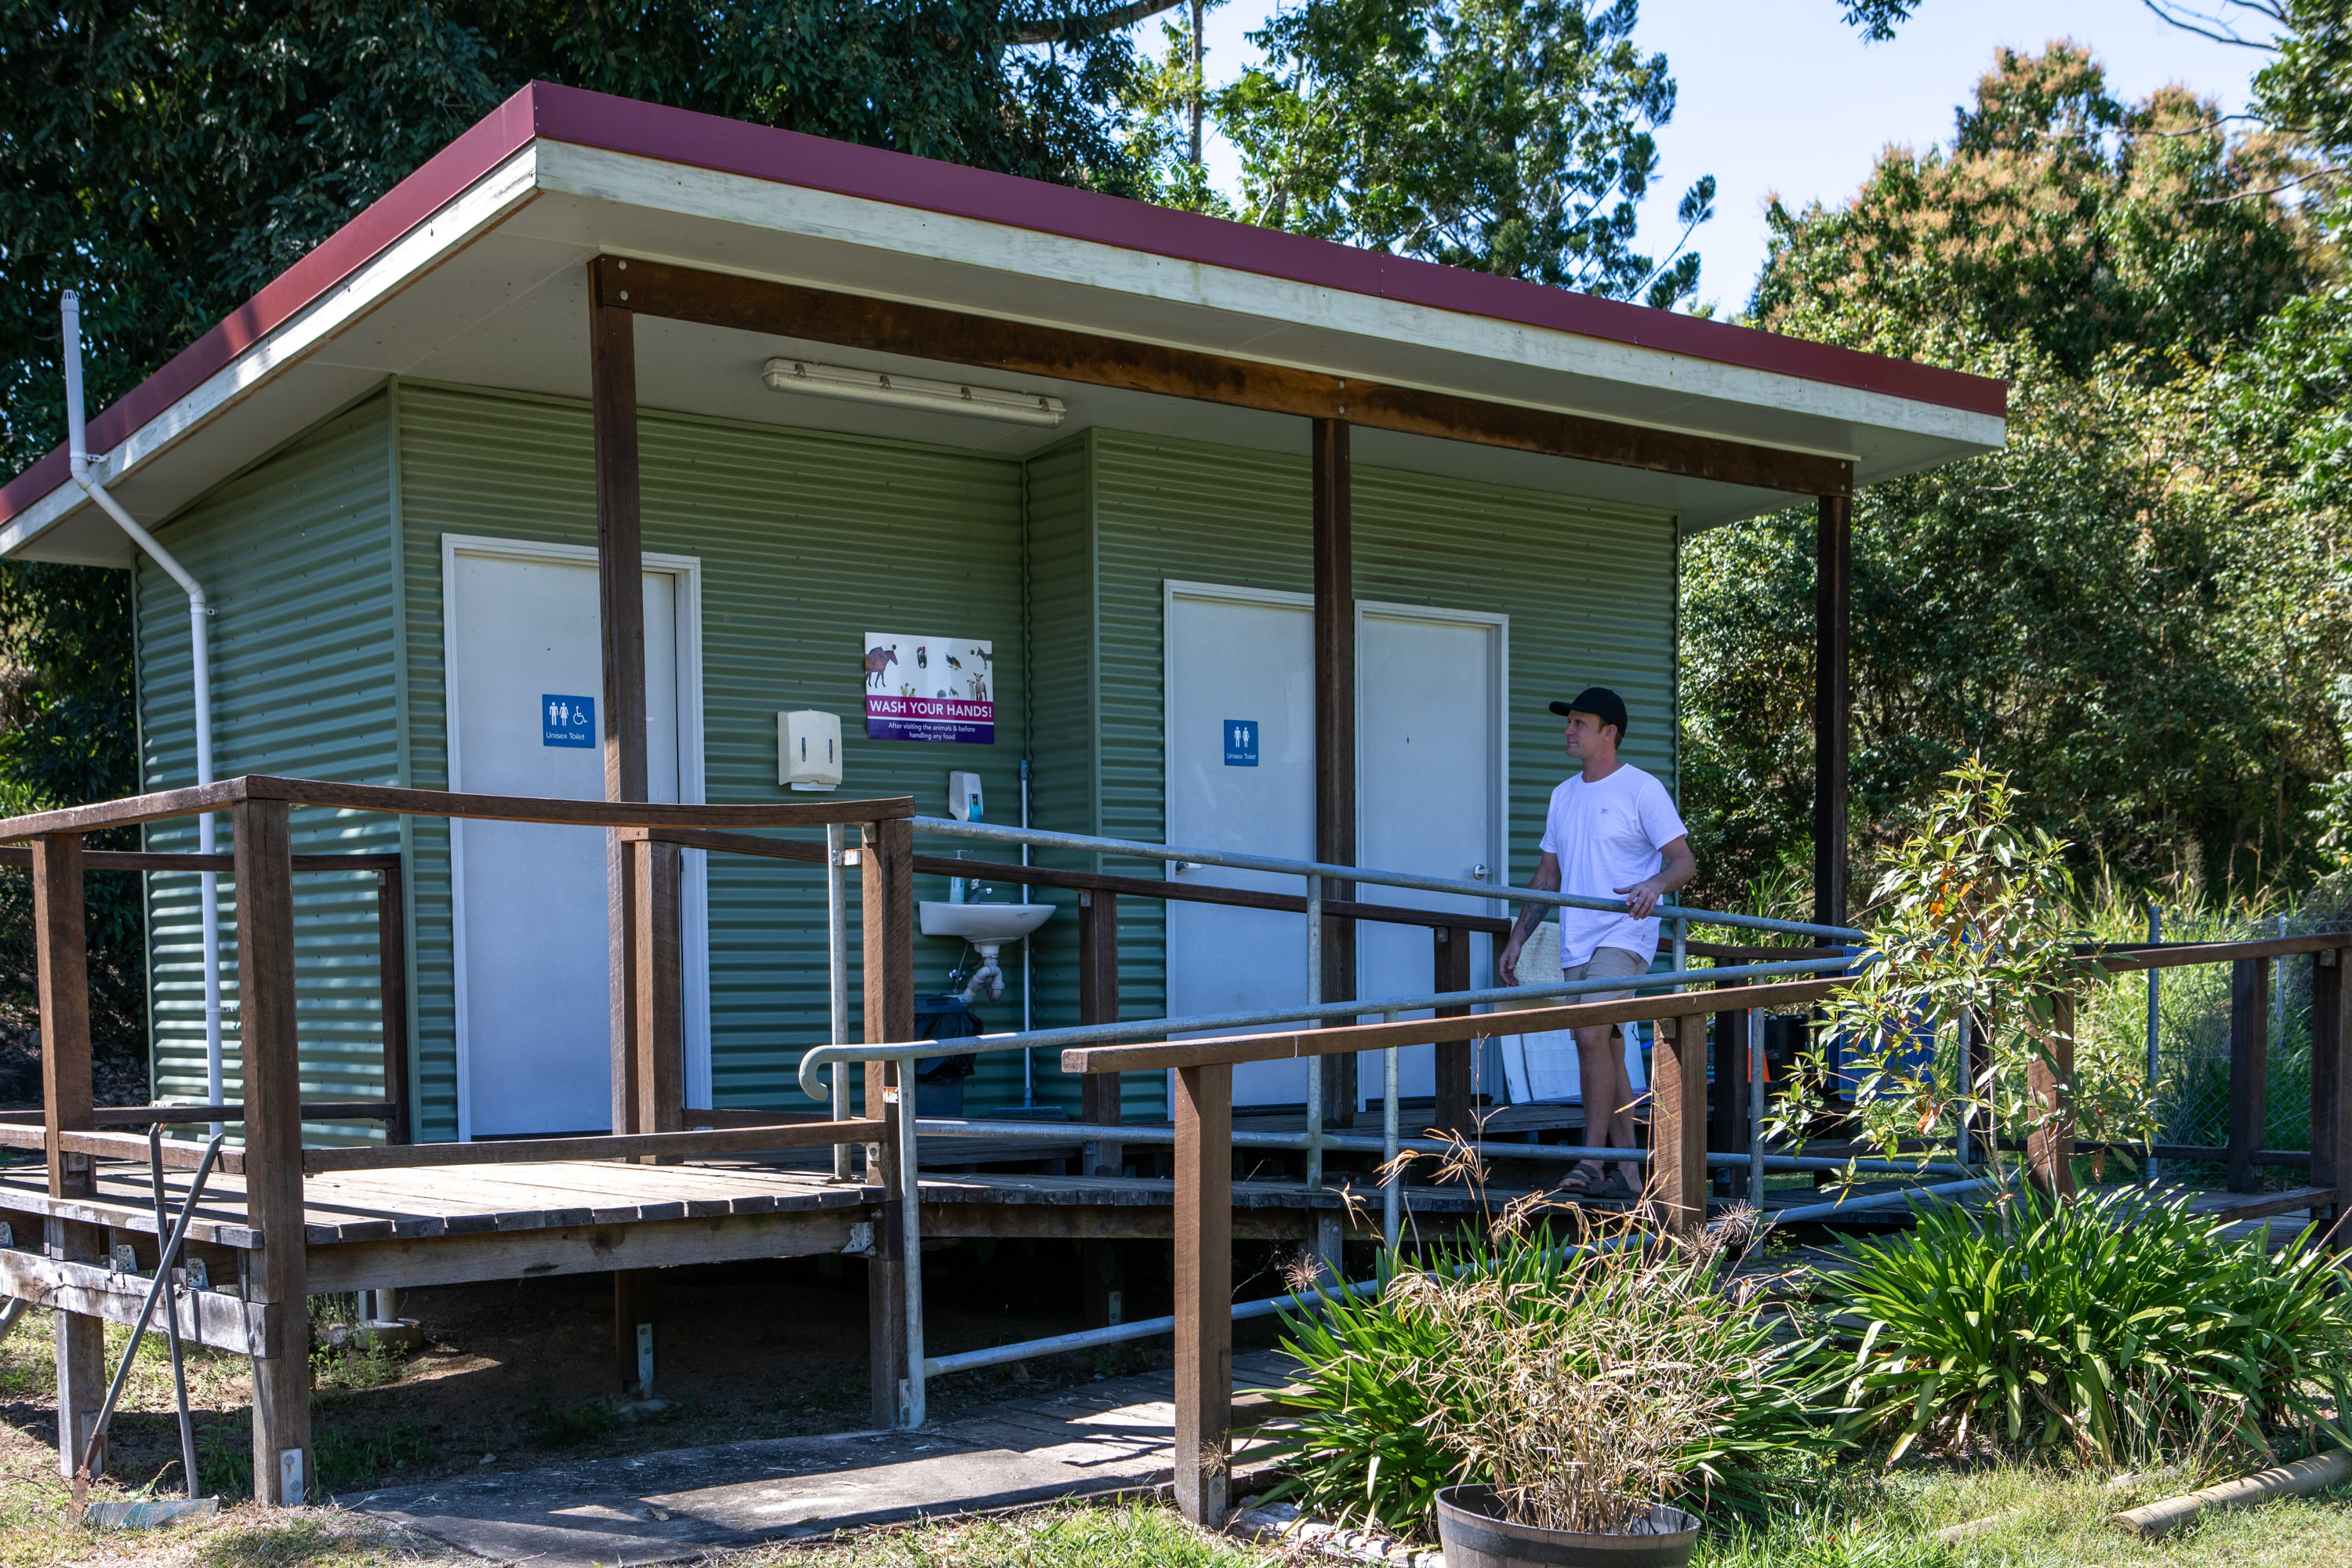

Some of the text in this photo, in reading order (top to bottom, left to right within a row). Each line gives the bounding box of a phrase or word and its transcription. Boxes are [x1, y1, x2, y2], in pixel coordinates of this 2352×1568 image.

[869, 700, 993, 717] WASH YOUR HANDS!
[909, 731, 931, 740] handling
